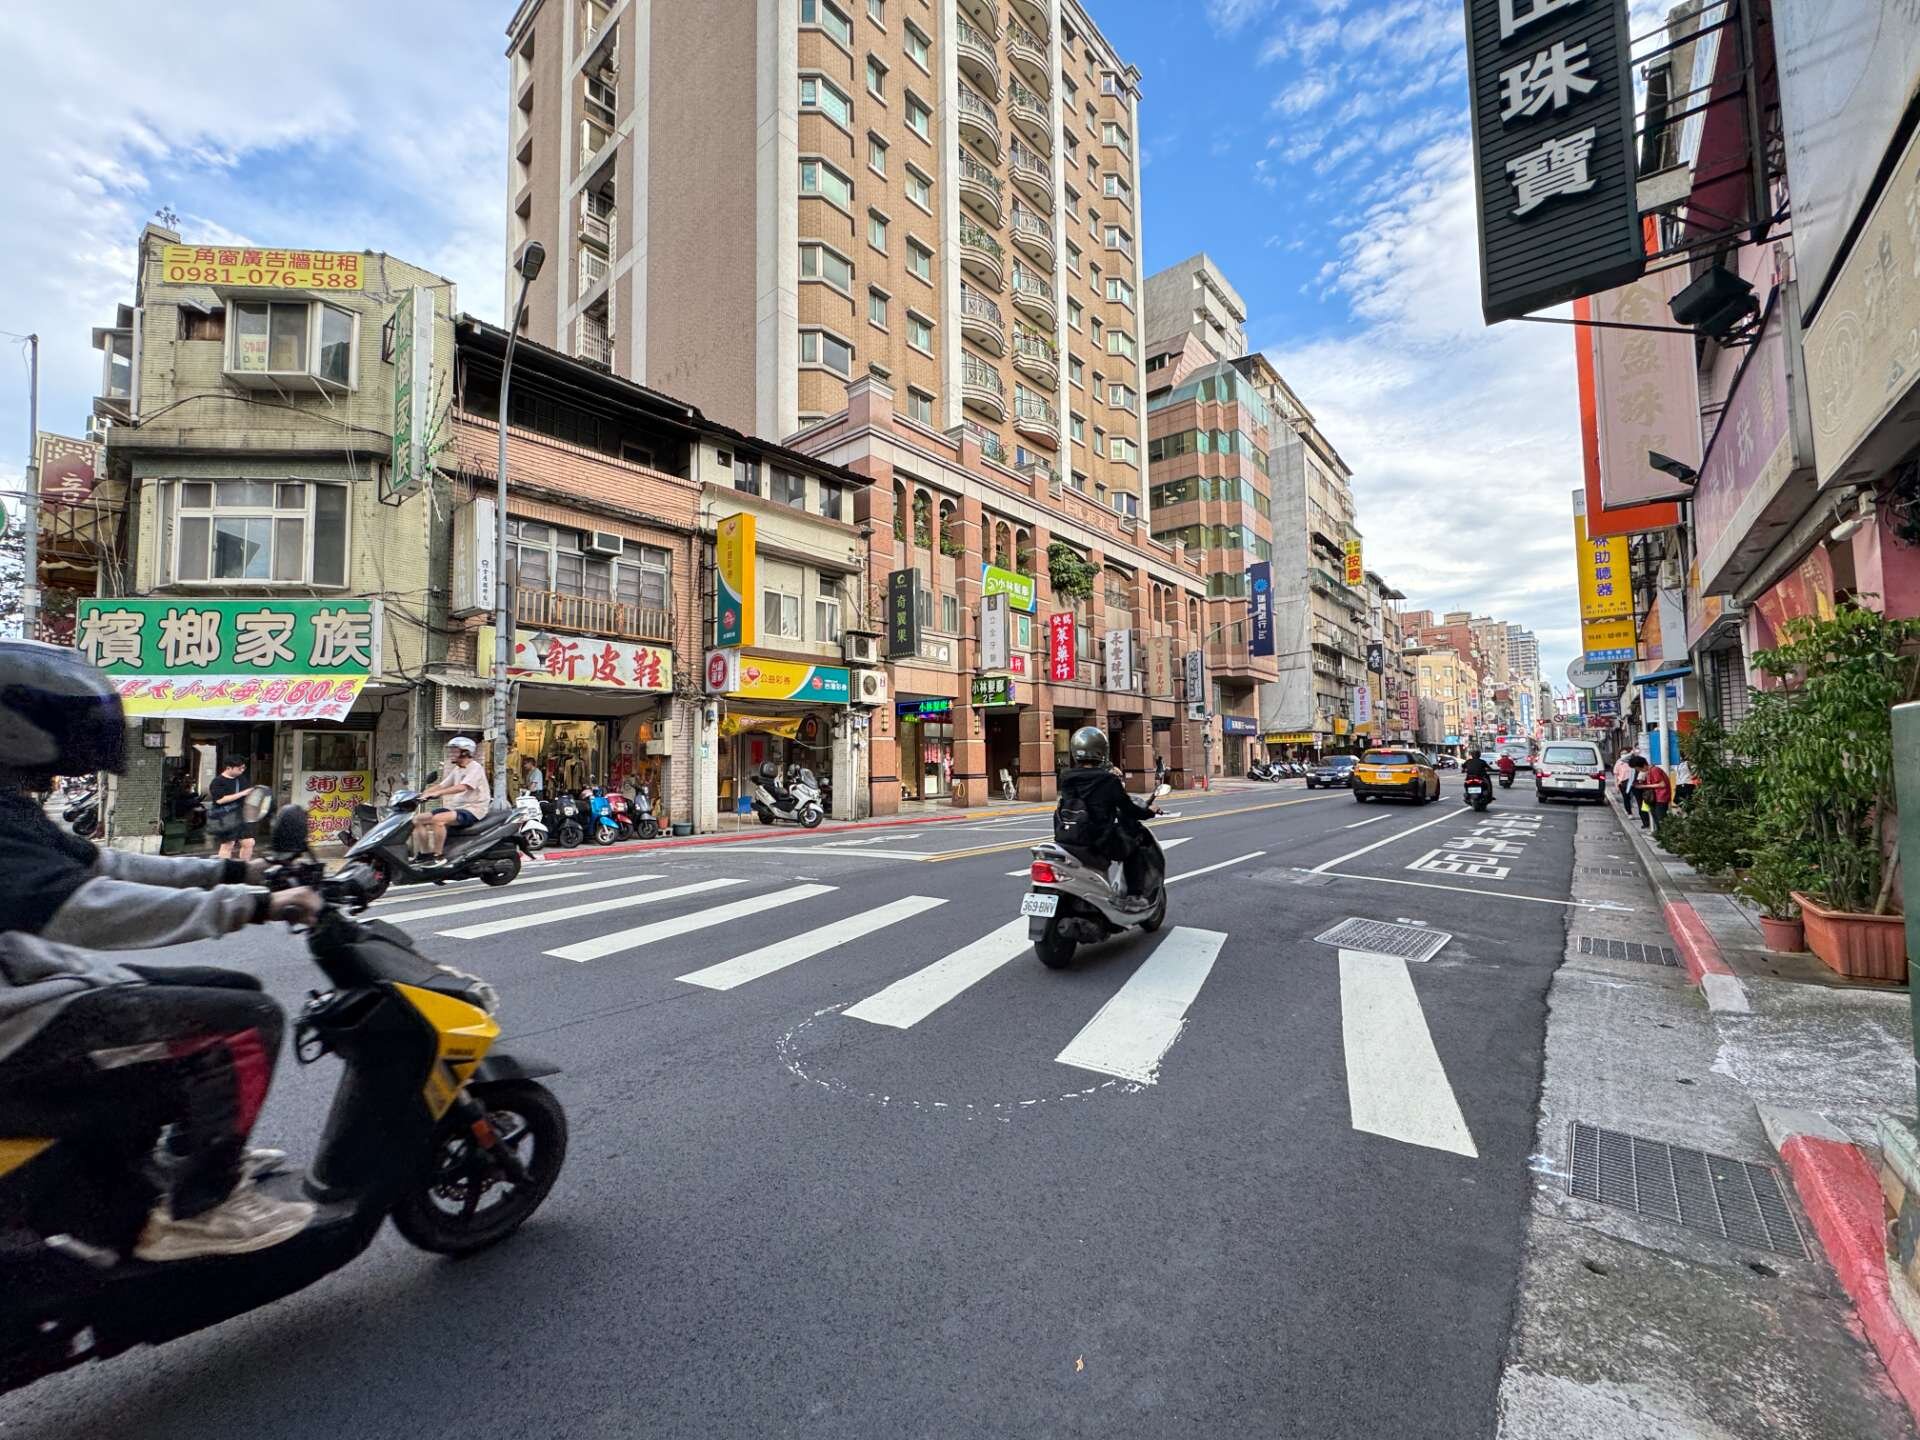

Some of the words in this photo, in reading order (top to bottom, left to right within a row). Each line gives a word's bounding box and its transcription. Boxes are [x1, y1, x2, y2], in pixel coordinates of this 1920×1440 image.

[169, 266, 358, 289] 0981-076-588
[80, 607, 372, 668] 檳榔家族
[493, 636, 663, 689] 新皮鞋
